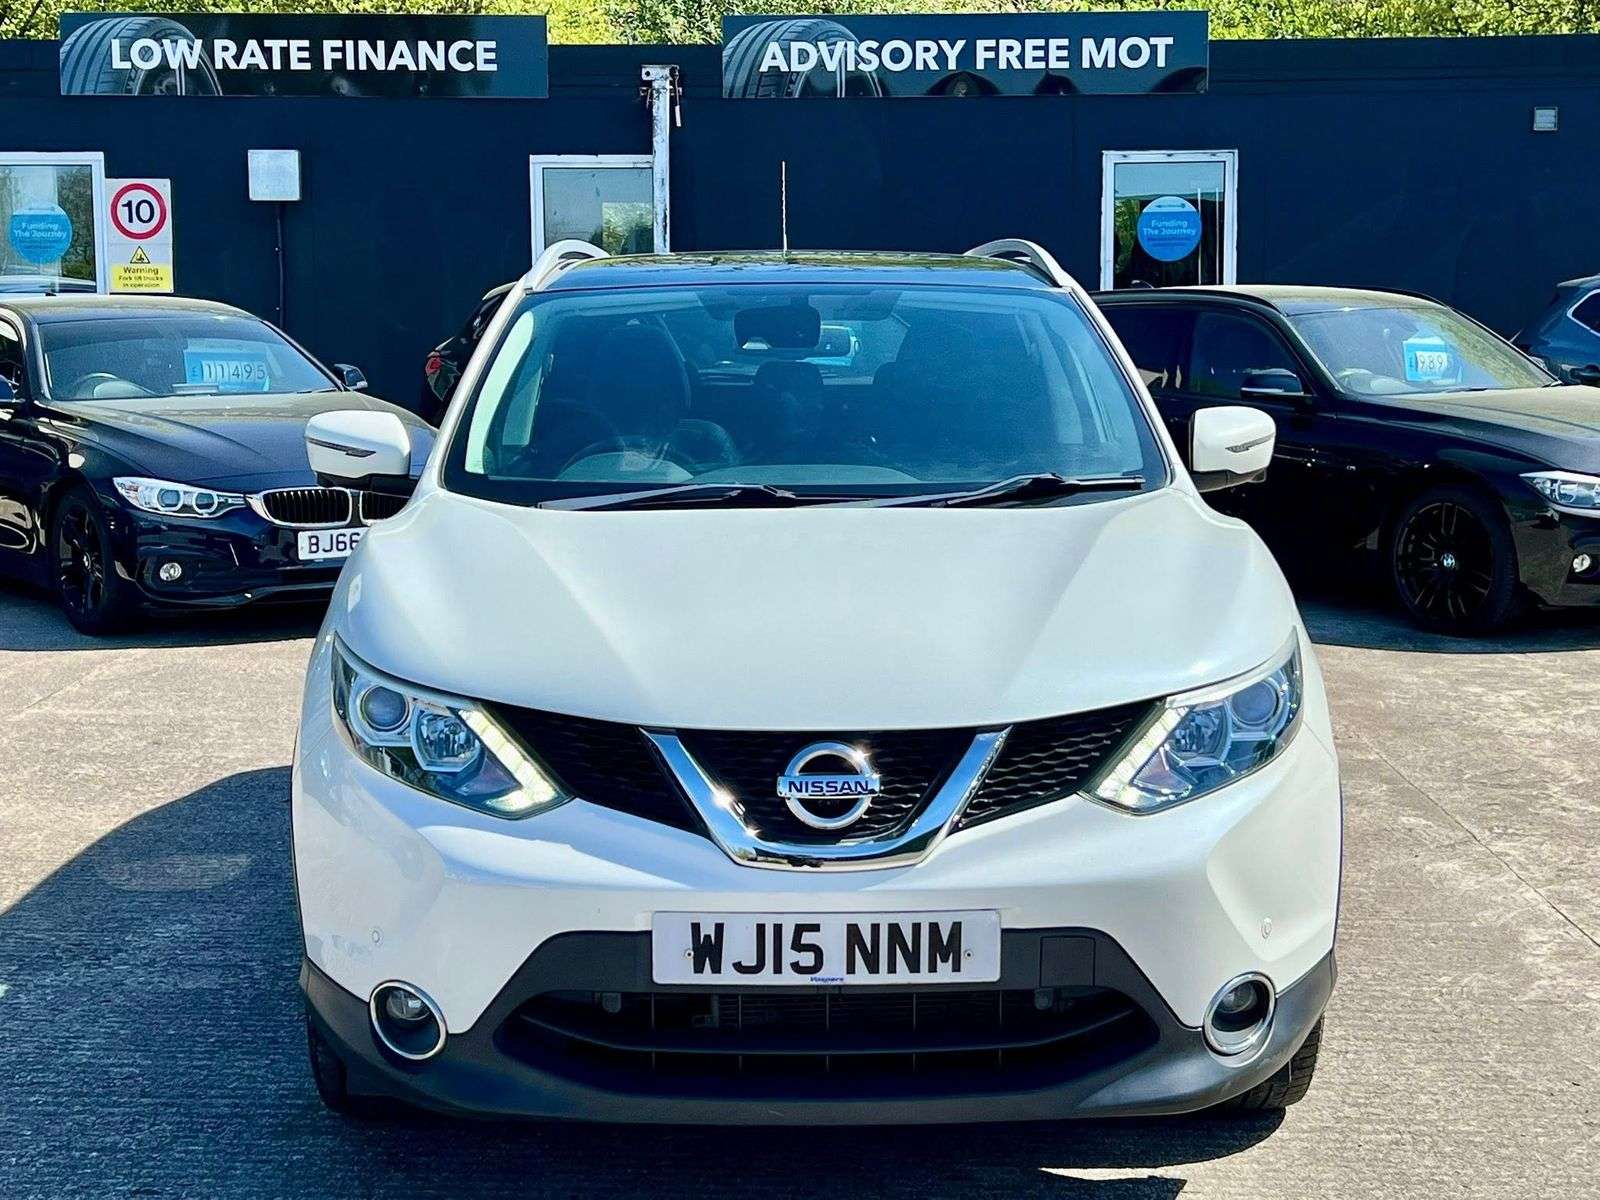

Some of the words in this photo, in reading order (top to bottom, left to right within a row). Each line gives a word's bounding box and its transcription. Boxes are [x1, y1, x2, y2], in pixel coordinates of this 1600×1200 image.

[111, 39, 203, 71] LOW
[214, 39, 311, 71] RATE
[323, 40, 498, 72] FINANCE
[759, 40, 967, 72] ADVISORY
[976, 38, 1069, 70] FREE
[1081, 37, 1174, 69] MOT
[121, 199, 155, 224] 10
[21, 222, 58, 230] Funding
[1151, 220, 1188, 228] Funding
[32, 230, 67, 238] Journey
[123, 267, 159, 275] Warning
[206, 363, 266, 380] 11495
[788, 780, 869, 793] NISSAN
[690, 921, 824, 975] WJ15
[846, 921, 963, 975] NNM
